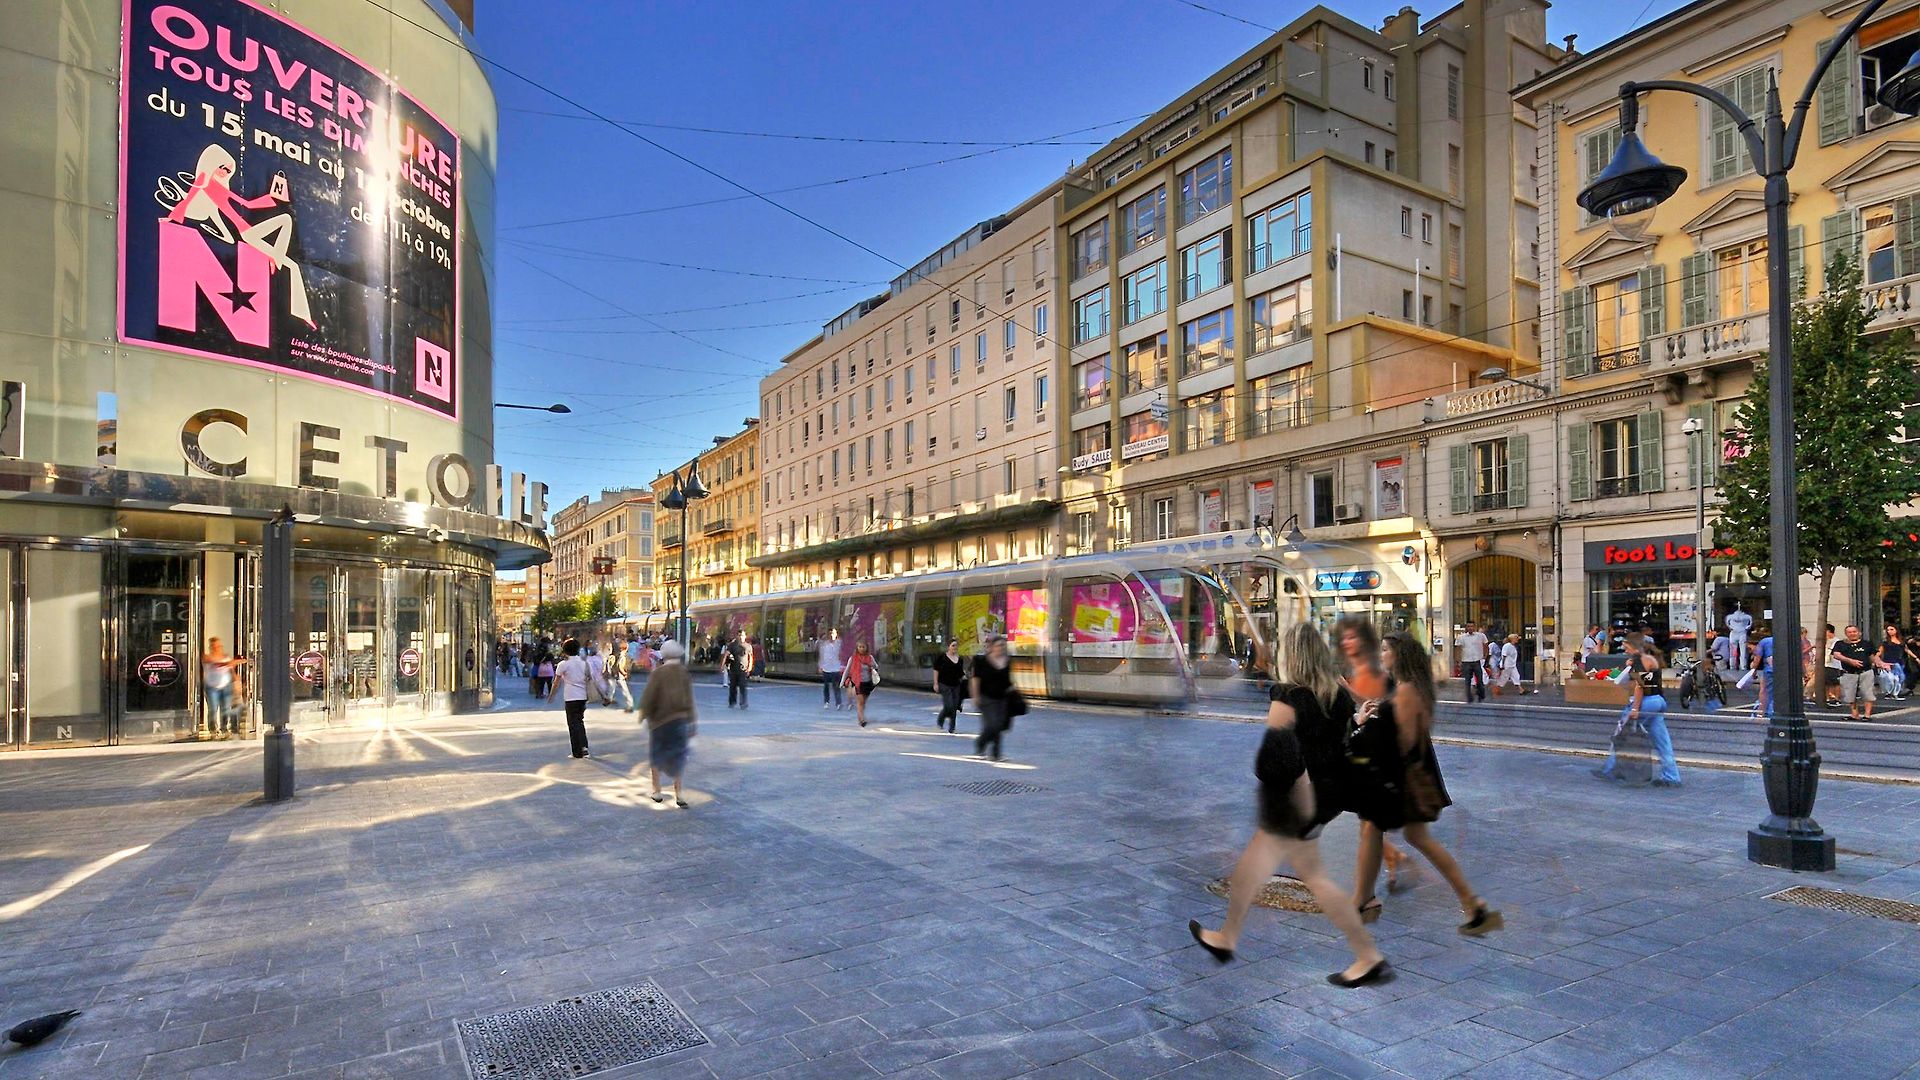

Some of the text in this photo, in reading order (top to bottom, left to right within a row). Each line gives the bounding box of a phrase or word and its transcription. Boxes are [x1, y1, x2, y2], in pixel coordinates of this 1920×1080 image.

[149, 46, 253, 102] TOUS
[264, 91, 314, 129] LES
[147, 87, 186, 118] du
[202, 103, 243, 137] 15
[254, 129, 311, 165] mai
[318, 157, 345, 181] au
[429, 241, 451, 270] 19h
[290, 337, 309, 349] Liste
[1605, 543, 1656, 565] Foot
